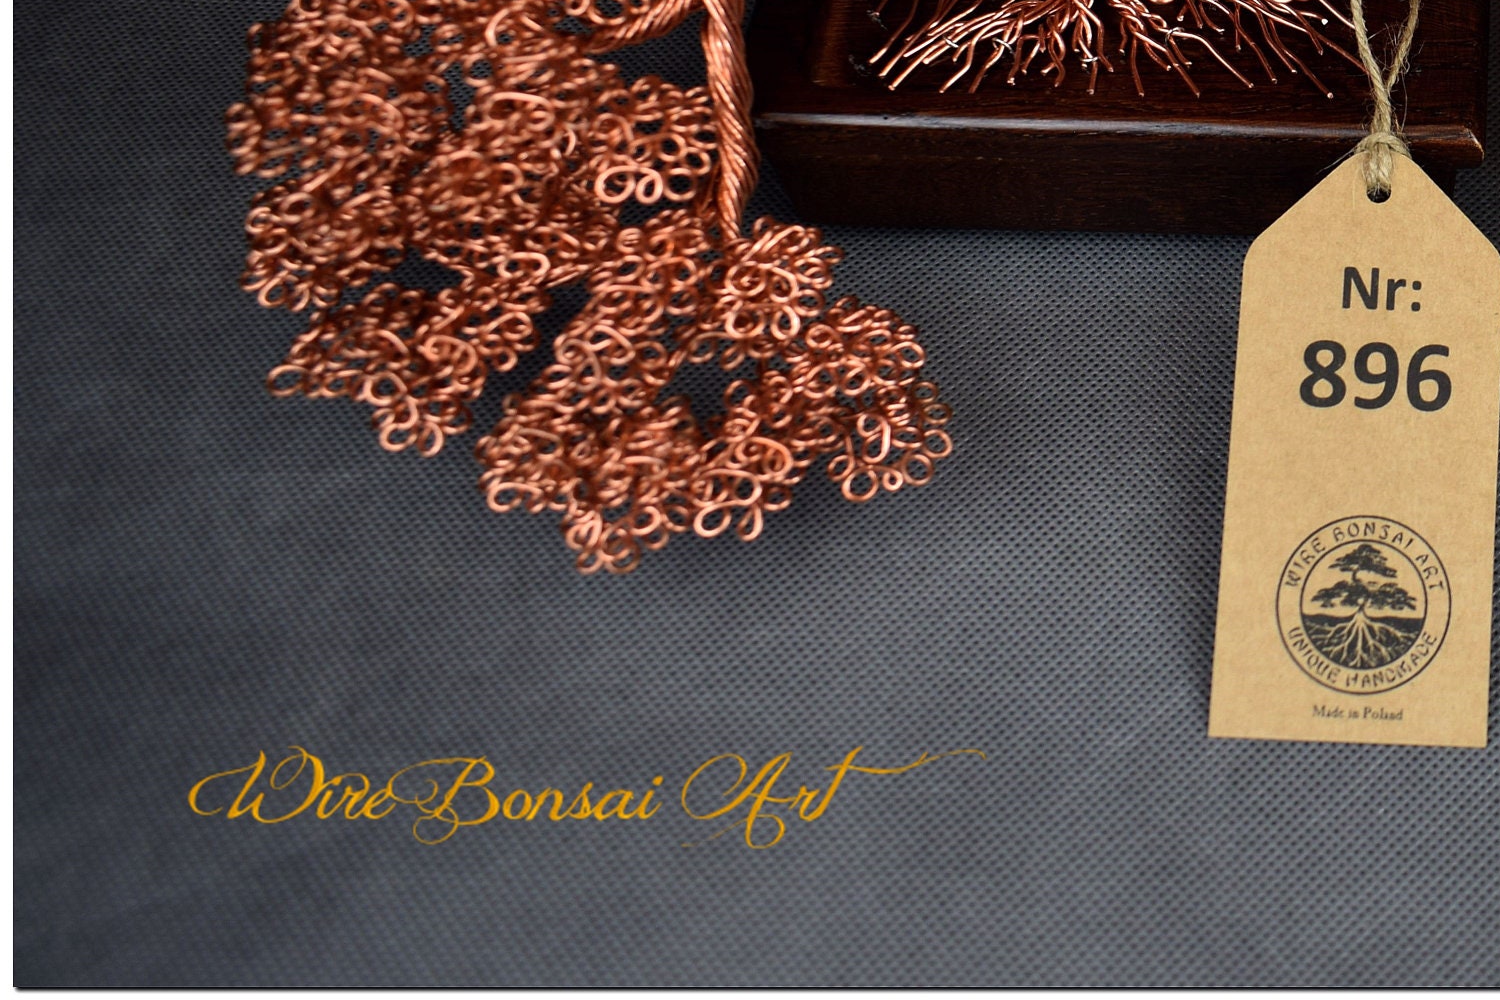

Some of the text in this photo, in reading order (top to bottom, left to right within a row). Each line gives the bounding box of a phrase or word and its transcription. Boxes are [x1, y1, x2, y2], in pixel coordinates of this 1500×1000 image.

[1340, 266, 1423, 312] Nr:
[1298, 340, 1453, 412] 896
[1285, 521, 1445, 591] WIRE BONSAI ART
[1288, 626, 1438, 689] UNIQUE HANDMADE
[1312, 704, 1404, 721] Made in Poland
